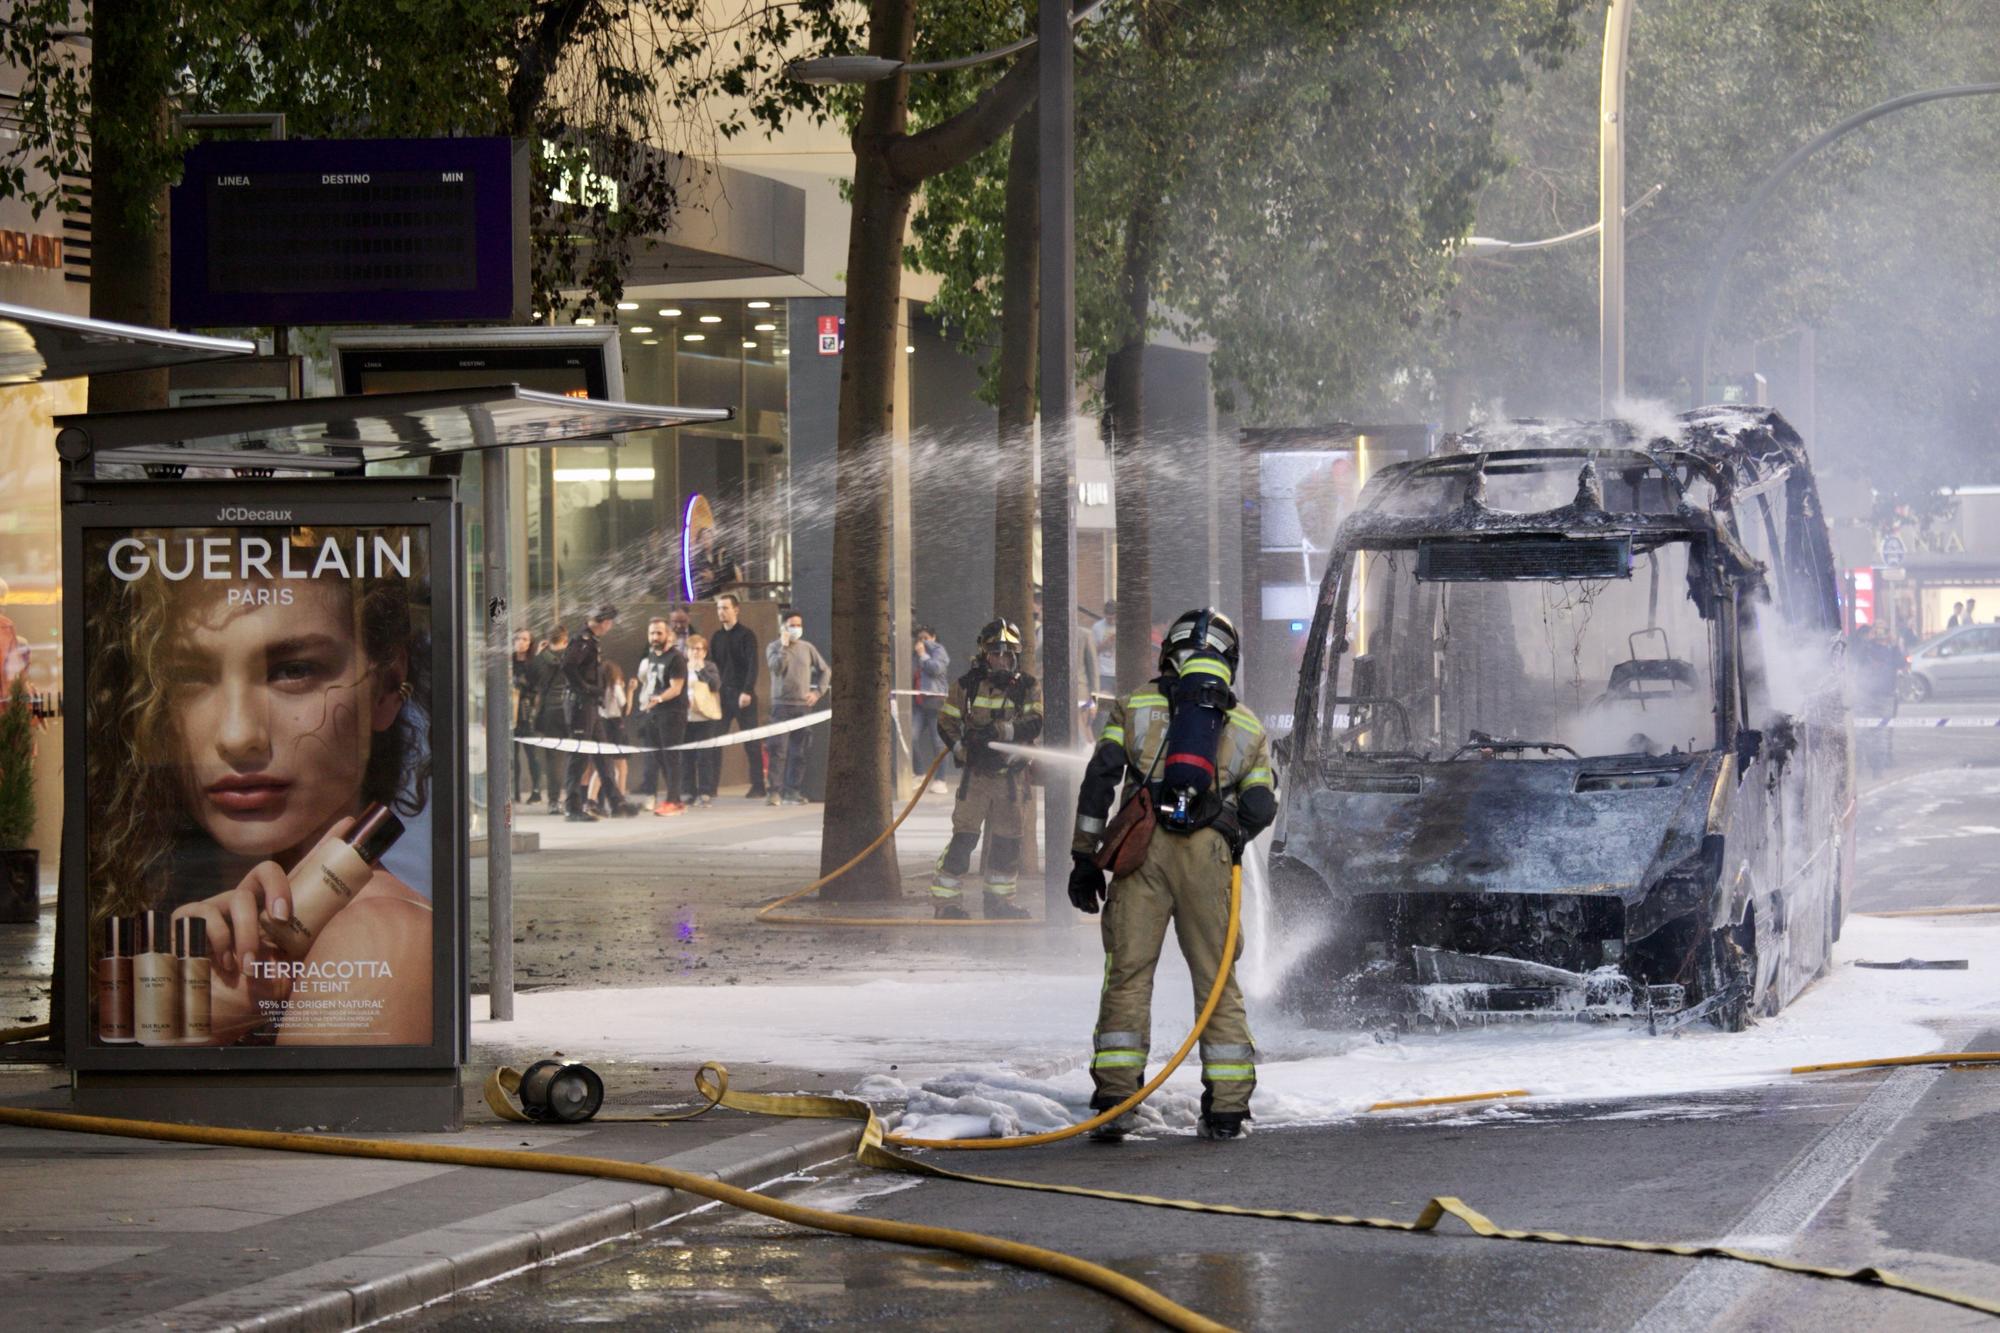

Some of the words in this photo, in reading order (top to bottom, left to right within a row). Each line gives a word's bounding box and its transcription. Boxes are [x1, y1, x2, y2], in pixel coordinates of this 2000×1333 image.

[217, 176, 250, 186] LINEA
[321, 174, 371, 185] DESTINO
[441, 172, 464, 182] MIN
[216, 507, 293, 521] JCDecaux
[107, 535, 411, 582] GUERLAIN
[227, 588, 294, 605] PARIS
[250, 961, 393, 979] TERRACOTTA
[292, 981, 308, 993] LE
[311, 981, 351, 993] TEINT
[258, 1000, 280, 1009] 95%
[281, 1000, 295, 1009] DE
[296, 1000, 336, 1009] ORIGEN
